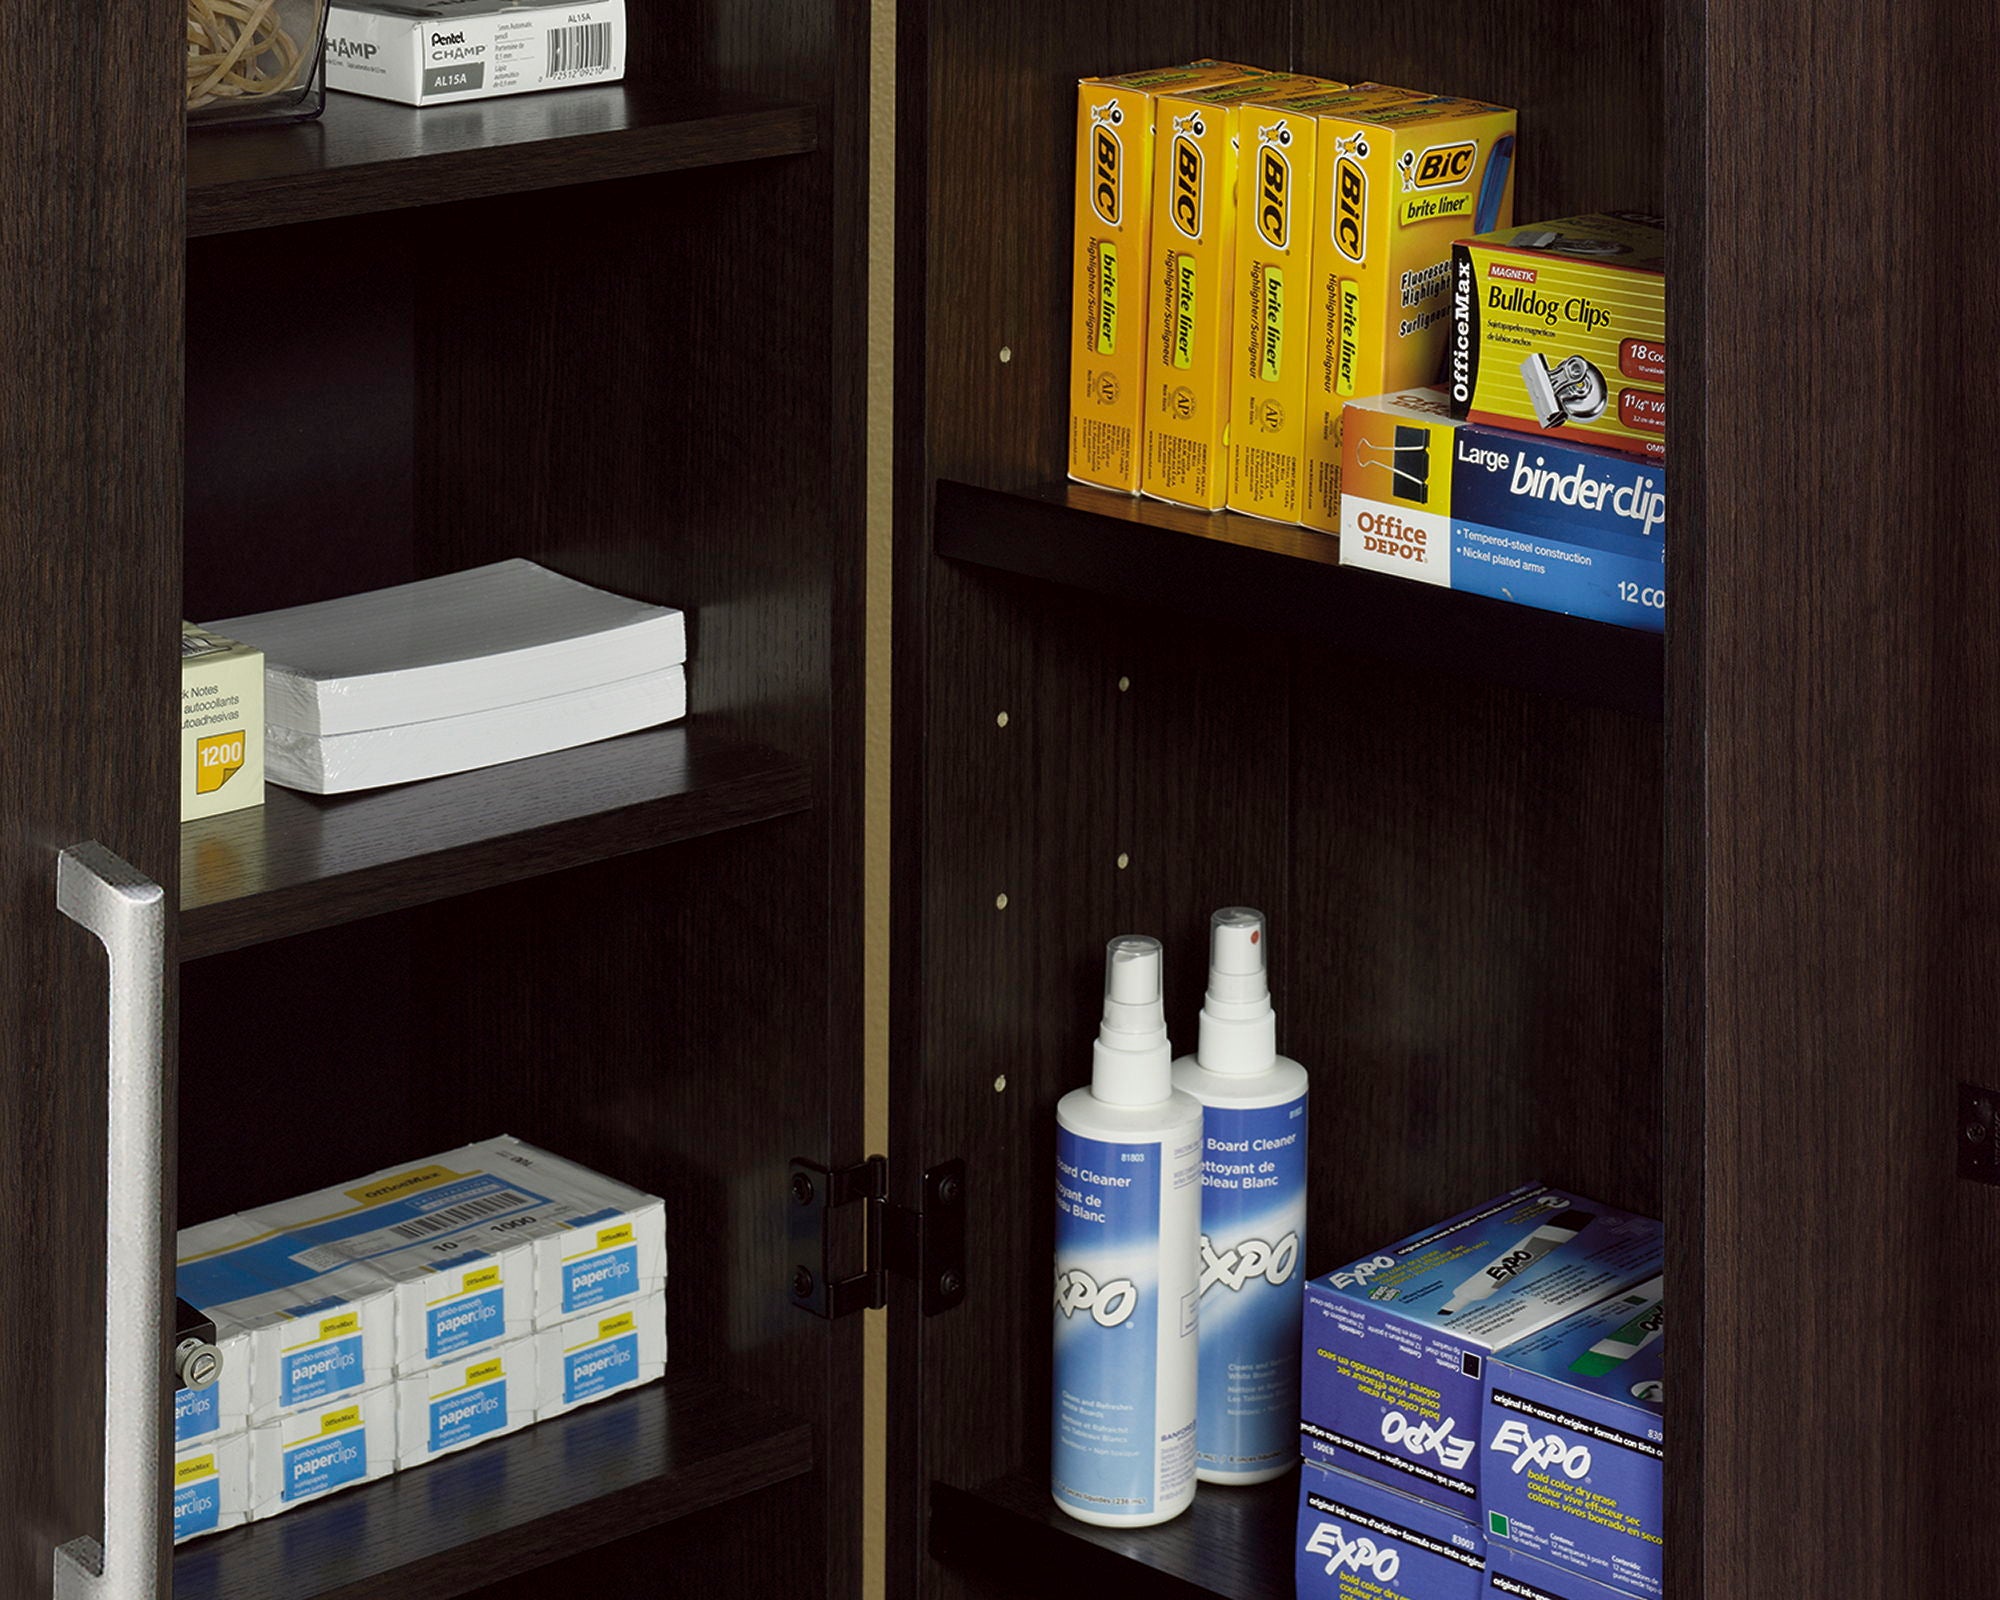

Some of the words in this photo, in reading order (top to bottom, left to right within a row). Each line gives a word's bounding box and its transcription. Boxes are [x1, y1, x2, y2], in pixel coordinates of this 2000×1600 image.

[568, 13, 591, 22] AL15A
[432, 32, 465, 47] Pentel
[432, 45, 485, 61] CHAMP
[434, 74, 467, 88] AL15A
[554, 71, 576, 80] 72512
[1408, 202, 1436, 218] brite
[1438, 196, 1465, 214] liner
[1103, 253, 1116, 298] brite
[1491, 266, 1534, 281] MAGNETIC
[1086, 237, 1097, 352] Highlighter/Surligneur
[1179, 267, 1194, 312] brite
[1267, 277, 1282, 322] brite
[1162, 249, 1174, 366] Highlighter/Surligneur
[1343, 291, 1358, 337] brite
[1488, 286, 1559, 325] Bulldog
[1564, 298, 1611, 332] Clips
[1102, 301, 1116, 343] liner
[1249, 260, 1261, 379] Highlighter/Surligneur
[1178, 314, 1193, 357] liner
[1324, 273, 1337, 393] Highlighter/Surligneur
[1454, 262, 1470, 402] OfficeMax
[1266, 325, 1281, 369] liner
[1631, 344, 1647, 359] 18
[1341, 338, 1356, 384] liner
[1102, 378, 1114, 400] AP
[1177, 392, 1190, 415] AP
[1265, 405, 1279, 428] AP
[1458, 440, 1510, 472] Large
[1357, 511, 1427, 547] Office
[1363, 536, 1426, 563] DEPOT
[1463, 528, 1534, 556] Tempered-steel
[1536, 545, 1592, 566] construction
[1463, 547, 1491, 564] Nickel
[1492, 553, 1521, 571] plated
[1522, 562, 1546, 575] arms
[1618, 581, 1638, 602] 12
[191, 685, 218, 698] Notes
[184, 696, 239, 714] autocollants
[201, 741, 242, 767] 1200
[1207, 1138, 1249, 1152] Board
[1252, 1133, 1297, 1151] Cleaner
[1121, 1153, 1144, 1162] 81803
[1258, 1161, 1275, 1173] de
[365, 1171, 441, 1198] OfficeMax
[1080, 1170, 1131, 1187] Cleaner
[1201, 1174, 1238, 1189] bleau
[1242, 1176, 1279, 1189] Blanc
[1085, 1195, 1102, 1207] de
[1072, 1205, 1106, 1223] Blanc
[433, 1241, 458, 1252] 10
[490, 1215, 537, 1232] 1000
[601, 1231, 628, 1242] OfficeMax
[572, 1255, 616, 1277] jumbo-smooth
[1200, 1231, 1298, 1294] XPO
[1329, 1255, 1395, 1290] EXPO
[1486, 1249, 1532, 1281] EXPO
[467, 1273, 496, 1286] OfficeMax
[573, 1262, 630, 1292] paperclips
[437, 1298, 482, 1320] jumbo-smooth
[324, 1321, 354, 1333] OfficeMax
[437, 1305, 496, 1337] paperclips
[602, 1320, 629, 1332] OfficeMax
[292, 1345, 339, 1368] jumbo-smooth
[574, 1343, 617, 1367] jumbo-smooth
[1317, 1348, 1337, 1361] seco
[1337, 1356, 1349, 1365] en
[292, 1353, 355, 1385] paperclips
[469, 1366, 498, 1379] OfficeMax
[574, 1350, 631, 1382] paperclips
[1336, 1365, 1351, 1376] sec
[1350, 1361, 1385, 1380] borrado
[1352, 1372, 1387, 1390] effaceur
[1357, 1384, 1380, 1398] erase
[1386, 1374, 1409, 1387] vivos
[1388, 1385, 1407, 1397] vive
[1409, 1382, 1440, 1399] colores
[439, 1391, 485, 1414] jumbo-smooth
[1381, 1391, 1396, 1405] dry
[1397, 1399, 1419, 1411] color
[1407, 1392, 1440, 1409] couleur
[325, 1414, 355, 1427] OfficeMax
[439, 1397, 498, 1430] paperclips
[1420, 1407, 1439, 1422] bold
[1493, 1394, 1521, 1410] original
[1522, 1403, 1533, 1413] ink
[1537, 1409, 1556, 1421] encre
[1594, 1427, 1623, 1444] formula
[1623, 1437, 1637, 1448] con
[1638, 1441, 1656, 1454] tinta
[1300, 1423, 1325, 1438] original
[1381, 1411, 1475, 1470] EXPO
[294, 1440, 342, 1463] jumbo-smooth
[1342, 1438, 1354, 1448] con
[1353, 1444, 1382, 1460] formula
[1490, 1419, 1592, 1480] EXPO
[178, 1462, 210, 1476] OfficeMax
[294, 1446, 357, 1480] paperclips
[1448, 1480, 1475, 1495] original
[1527, 1468, 1549, 1484] bold
[1550, 1480, 1574, 1492] color
[1575, 1486, 1592, 1500] dry
[1592, 1493, 1617, 1508] erase
[1527, 1482, 1562, 1498] couleur
[1564, 1494, 1584, 1507] vive
[1584, 1501, 1624, 1520] effaceur
[1625, 1515, 1641, 1526] sec
[1527, 1492, 1561, 1509] colores
[1562, 1504, 1587, 1518] vivos
[1588, 1511, 1626, 1532] borrado
[1627, 1527, 1640, 1537] en
[1641, 1532, 1663, 1545] seco
[1309, 1497, 1334, 1512] original
[1402, 1530, 1430, 1548] formula
[1430, 1542, 1443, 1553] con
[1460, 1553, 1486, 1569] original
[1305, 1522, 1400, 1582] EXPO
[1340, 1570, 1359, 1585] bold
[1360, 1580, 1383, 1594] color
[1384, 1588, 1400, 1600] dry
[1340, 1583, 1372, 1600] couleur
[1492, 1576, 1520, 1594] original
[1521, 1586, 1532, 1598] ink
